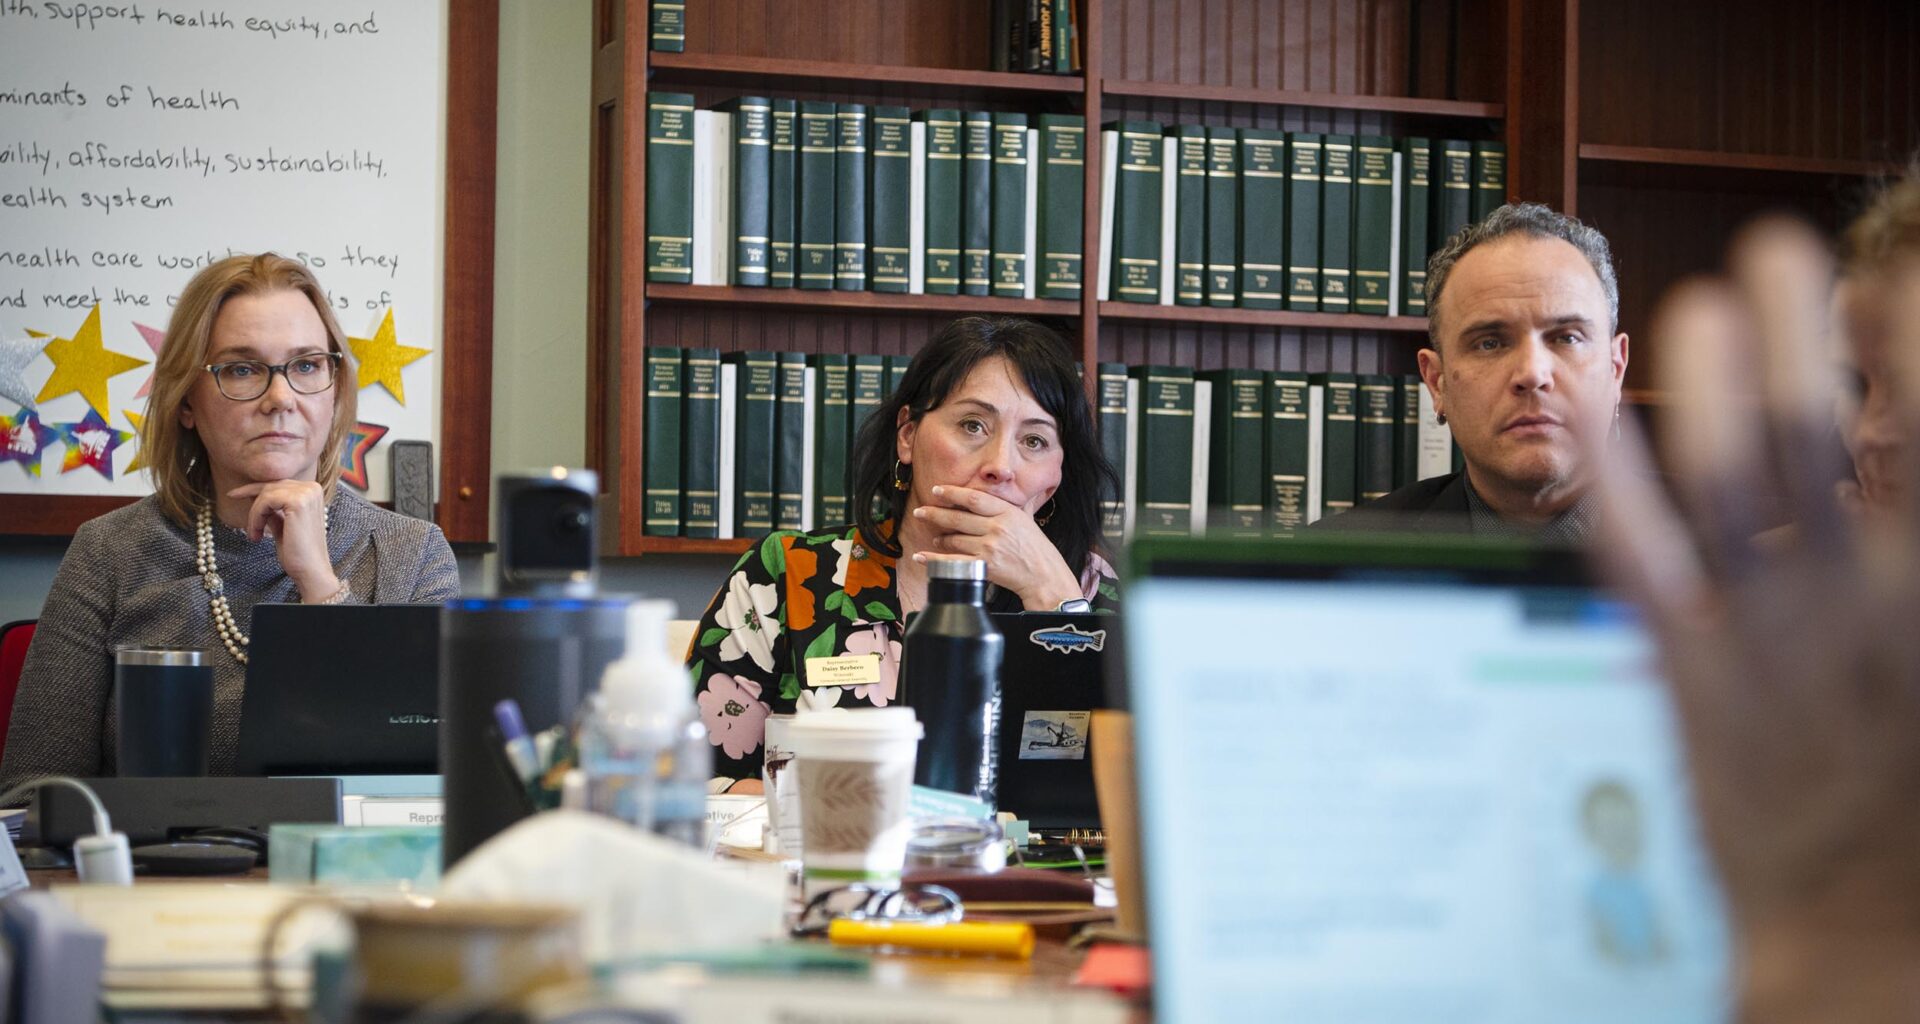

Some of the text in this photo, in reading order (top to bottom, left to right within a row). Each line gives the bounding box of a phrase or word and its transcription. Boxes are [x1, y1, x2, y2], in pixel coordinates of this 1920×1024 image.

[44, 2, 145, 31] support
[157, 6, 234, 30] health
[245, 15, 329, 40] equity,
[334, 7, 380, 35] and
[1040, 7, 1051, 58] JOURNEY
[0, 81, 240, 111] minants of health
[69, 141, 216, 176] affordability,
[224, 147, 389, 177] sustainability,
[2, 187, 174, 216] ealth system
[92, 251, 144, 268] care
[296, 252, 327, 271] so
[340, 245, 400, 278] they
[0, 288, 27, 308] nd
[43, 286, 102, 309] meet
[113, 286, 150, 306] the
[366, 291, 392, 309] of
